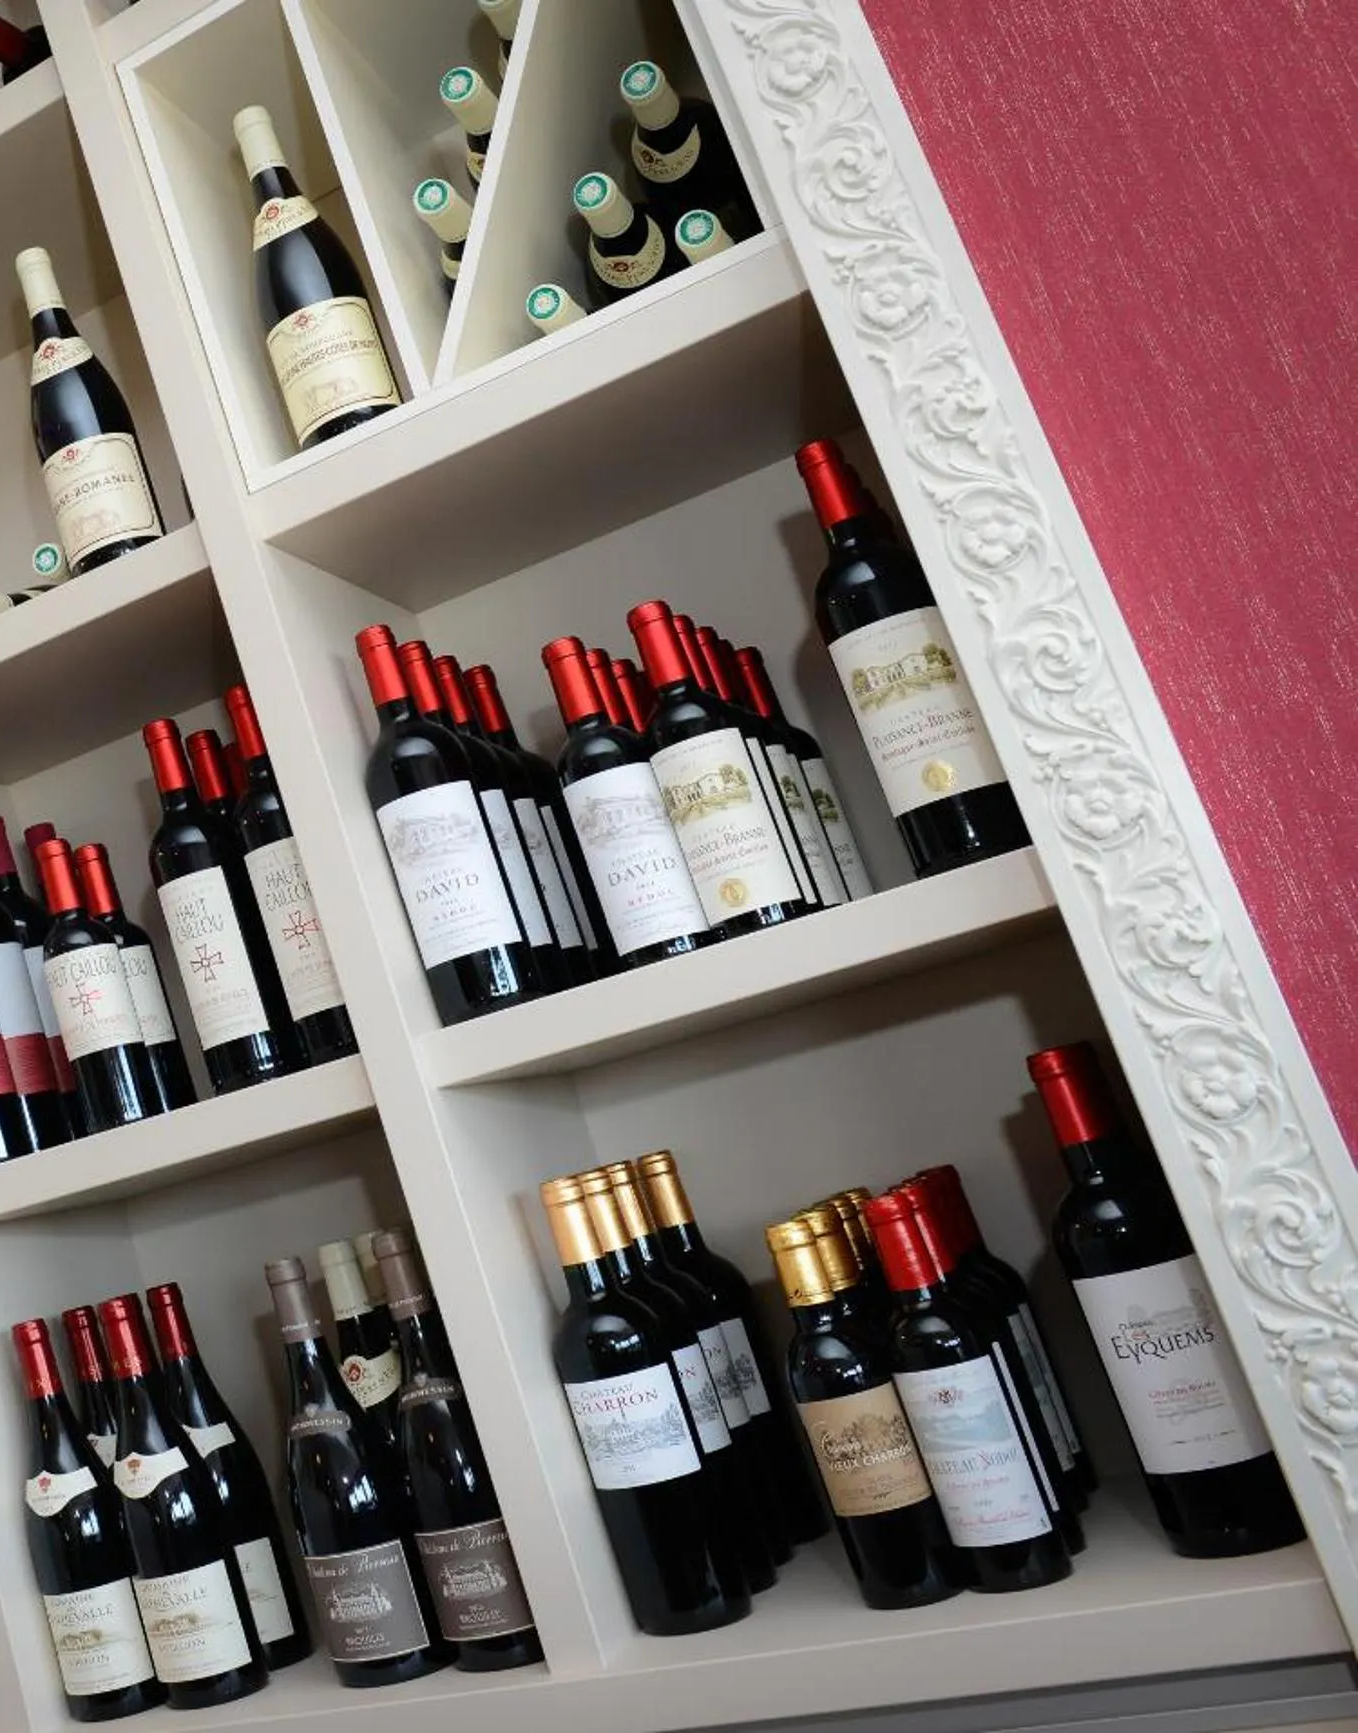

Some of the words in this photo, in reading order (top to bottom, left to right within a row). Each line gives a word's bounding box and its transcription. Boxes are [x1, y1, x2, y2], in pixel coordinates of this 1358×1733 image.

[607, 854, 678, 887] DAVID
[416, 872, 480, 904] DAVID
[1110, 1326, 1216, 1365] EYQUEMS
